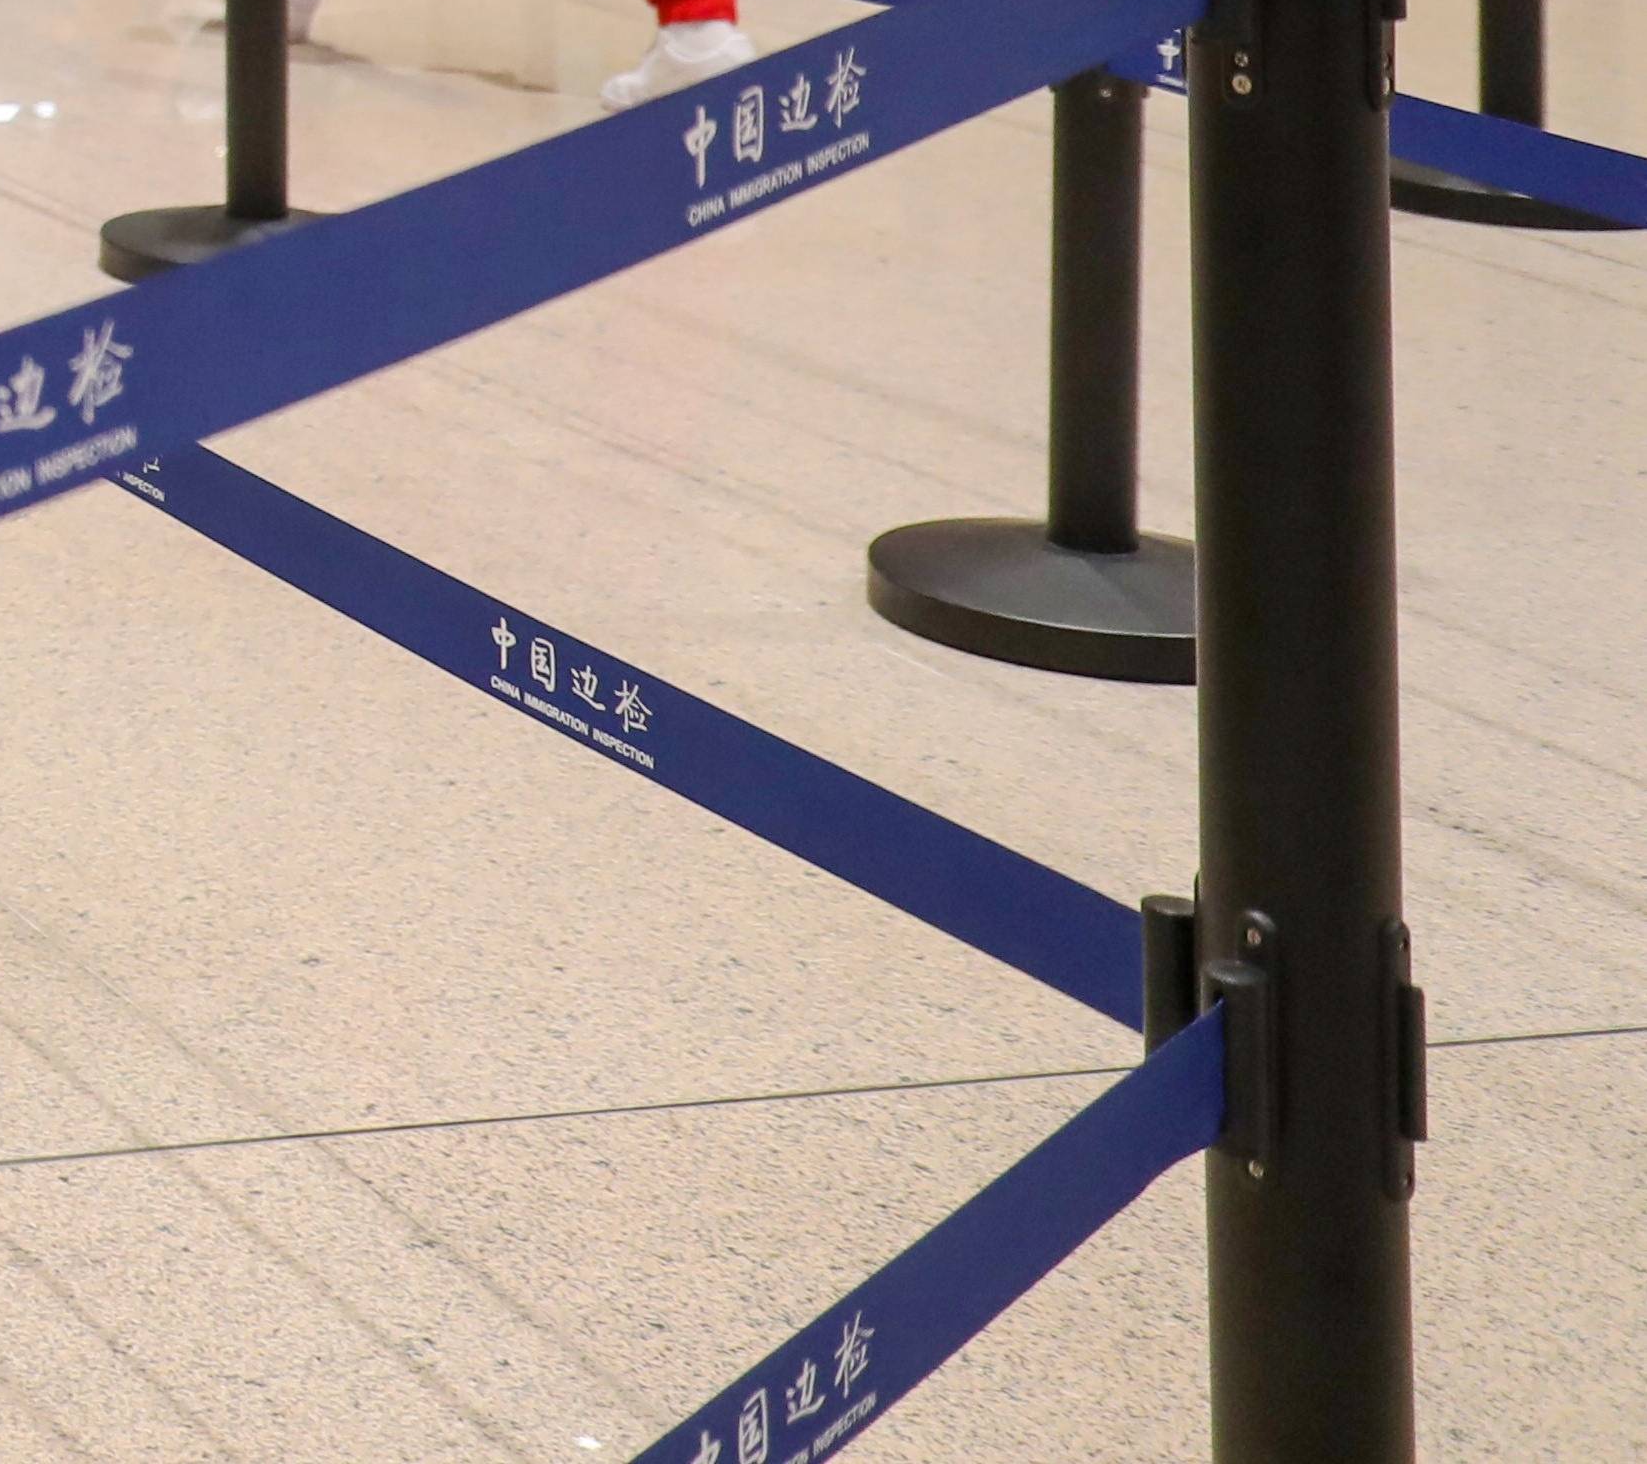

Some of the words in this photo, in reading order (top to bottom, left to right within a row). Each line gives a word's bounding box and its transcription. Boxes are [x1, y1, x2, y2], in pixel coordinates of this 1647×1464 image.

[683, 46, 867, 190] 中国边检
[687, 194, 726, 228] CHINA
[730, 160, 804, 210] IMMIGRATION
[807, 130, 871, 176] INSPECTION
[491, 616, 653, 733] 中国边检
[491, 675, 521, 702] CHINA
[524, 692, 589, 736] IMMIGRATION
[593, 728, 654, 769] INSPECTION
[813, 1391, 877, 1458] INSPECTION
